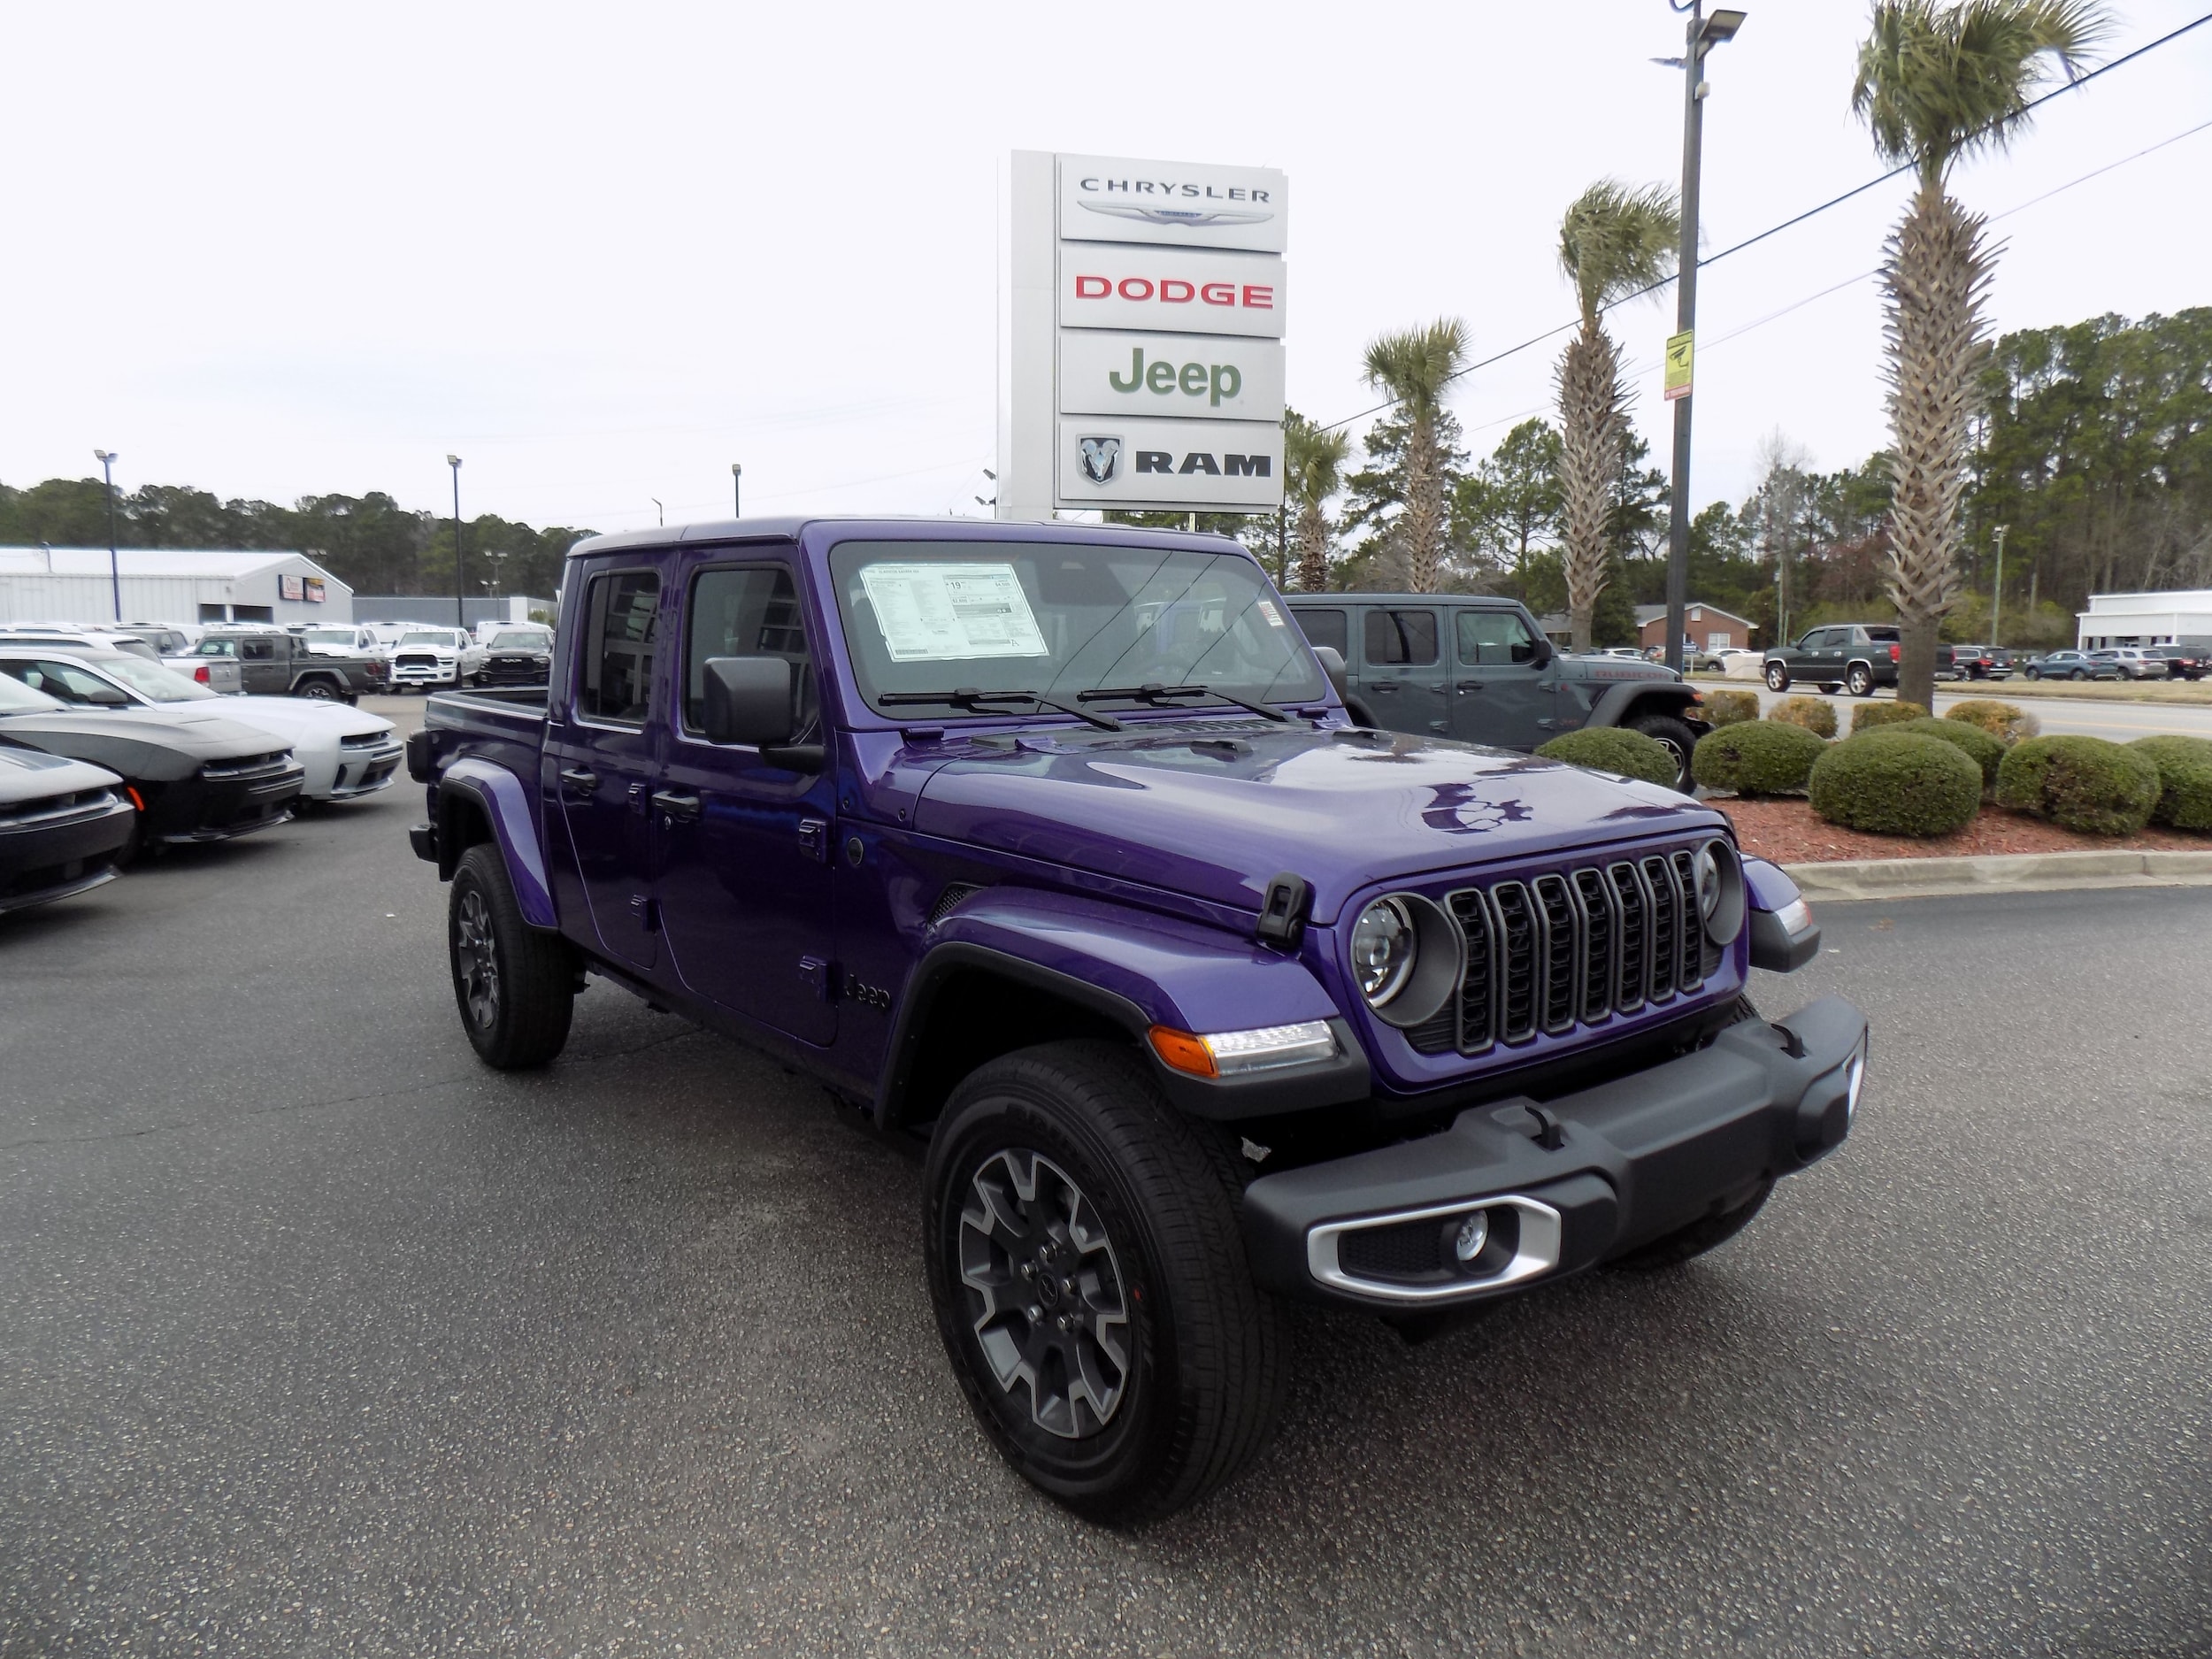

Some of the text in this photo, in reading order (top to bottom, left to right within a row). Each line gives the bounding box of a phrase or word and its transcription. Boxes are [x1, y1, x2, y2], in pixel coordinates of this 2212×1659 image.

[1080, 179, 1271, 203] CHRYSLER
[1076, 275, 1274, 310] DODGE
[1110, 348, 1241, 407] Jeep
[1135, 450, 1271, 477] RAM
[1594, 670, 1670, 680] RUBICON
[843, 973, 891, 1010] Jeep
